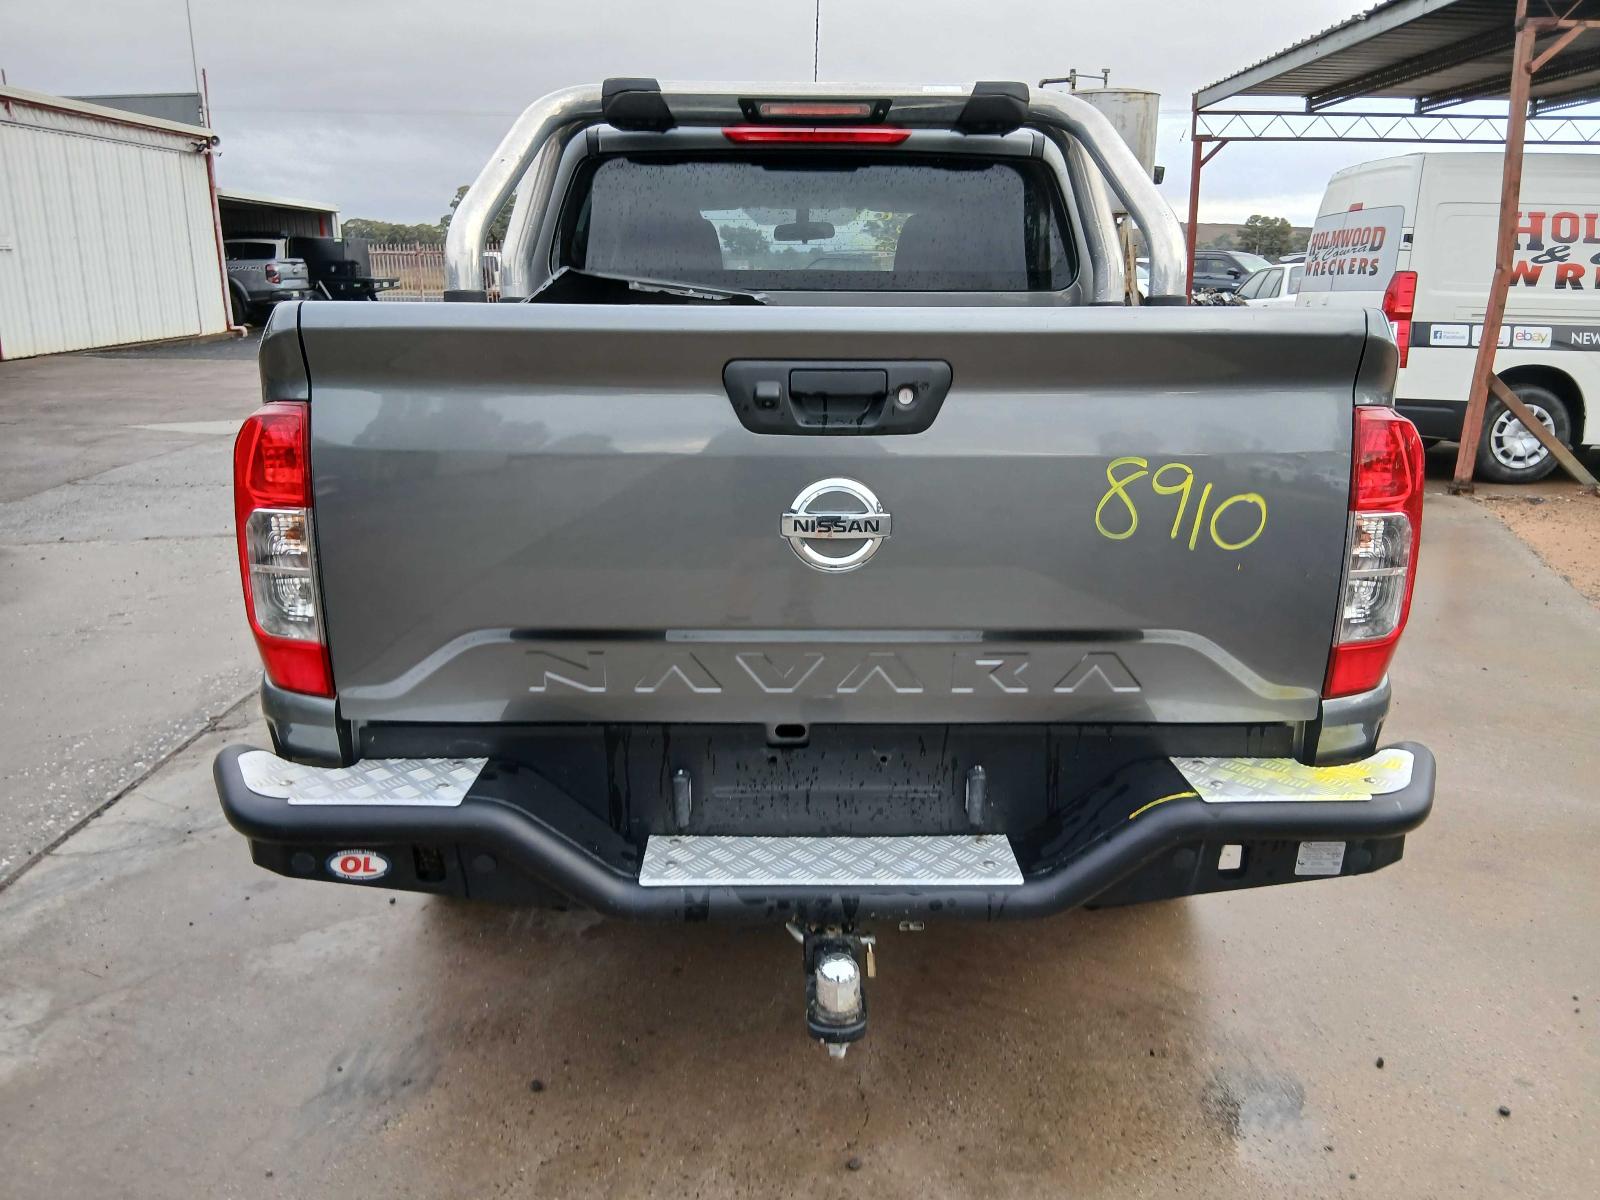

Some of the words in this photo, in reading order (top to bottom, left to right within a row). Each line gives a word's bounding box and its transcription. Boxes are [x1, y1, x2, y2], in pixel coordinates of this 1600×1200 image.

[1309, 226, 1386, 257] HOLMWOOD
[1530, 245, 1571, 264] &
[1305, 257, 1379, 277] WRECKERS
[1509, 260, 1600, 290] WR
[1515, 329, 1548, 344] ebay
[1571, 331, 1600, 345] NEW
[1095, 456, 1267, 550] 8910
[793, 519, 880, 533] NISSAN
[525, 650, 1142, 692] NAVARA
[340, 855, 377, 874] OL
